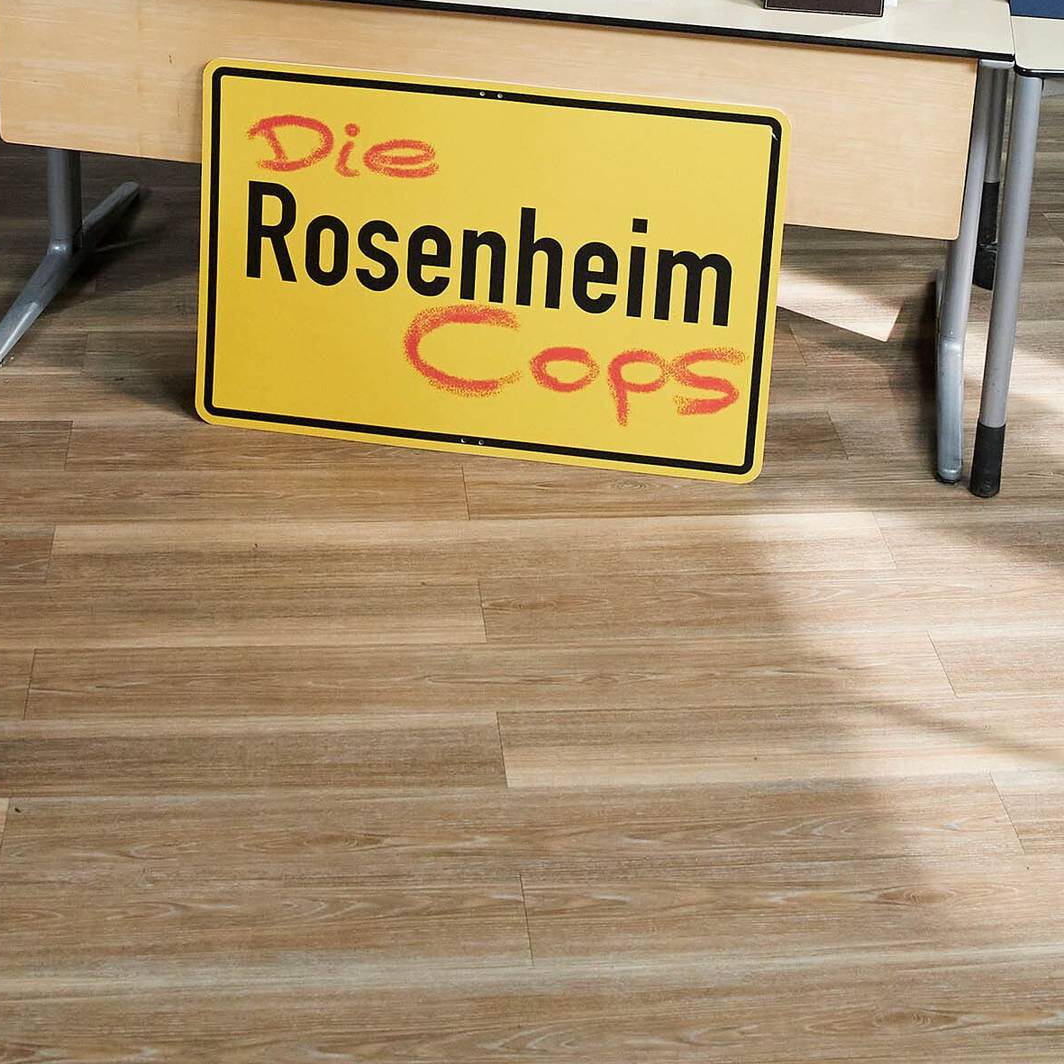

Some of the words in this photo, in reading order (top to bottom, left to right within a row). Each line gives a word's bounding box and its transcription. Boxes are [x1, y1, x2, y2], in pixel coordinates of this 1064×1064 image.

[247, 114, 439, 178] Die
[246, 180, 733, 327] Rosenheim
[403, 303, 747, 427] Cops
